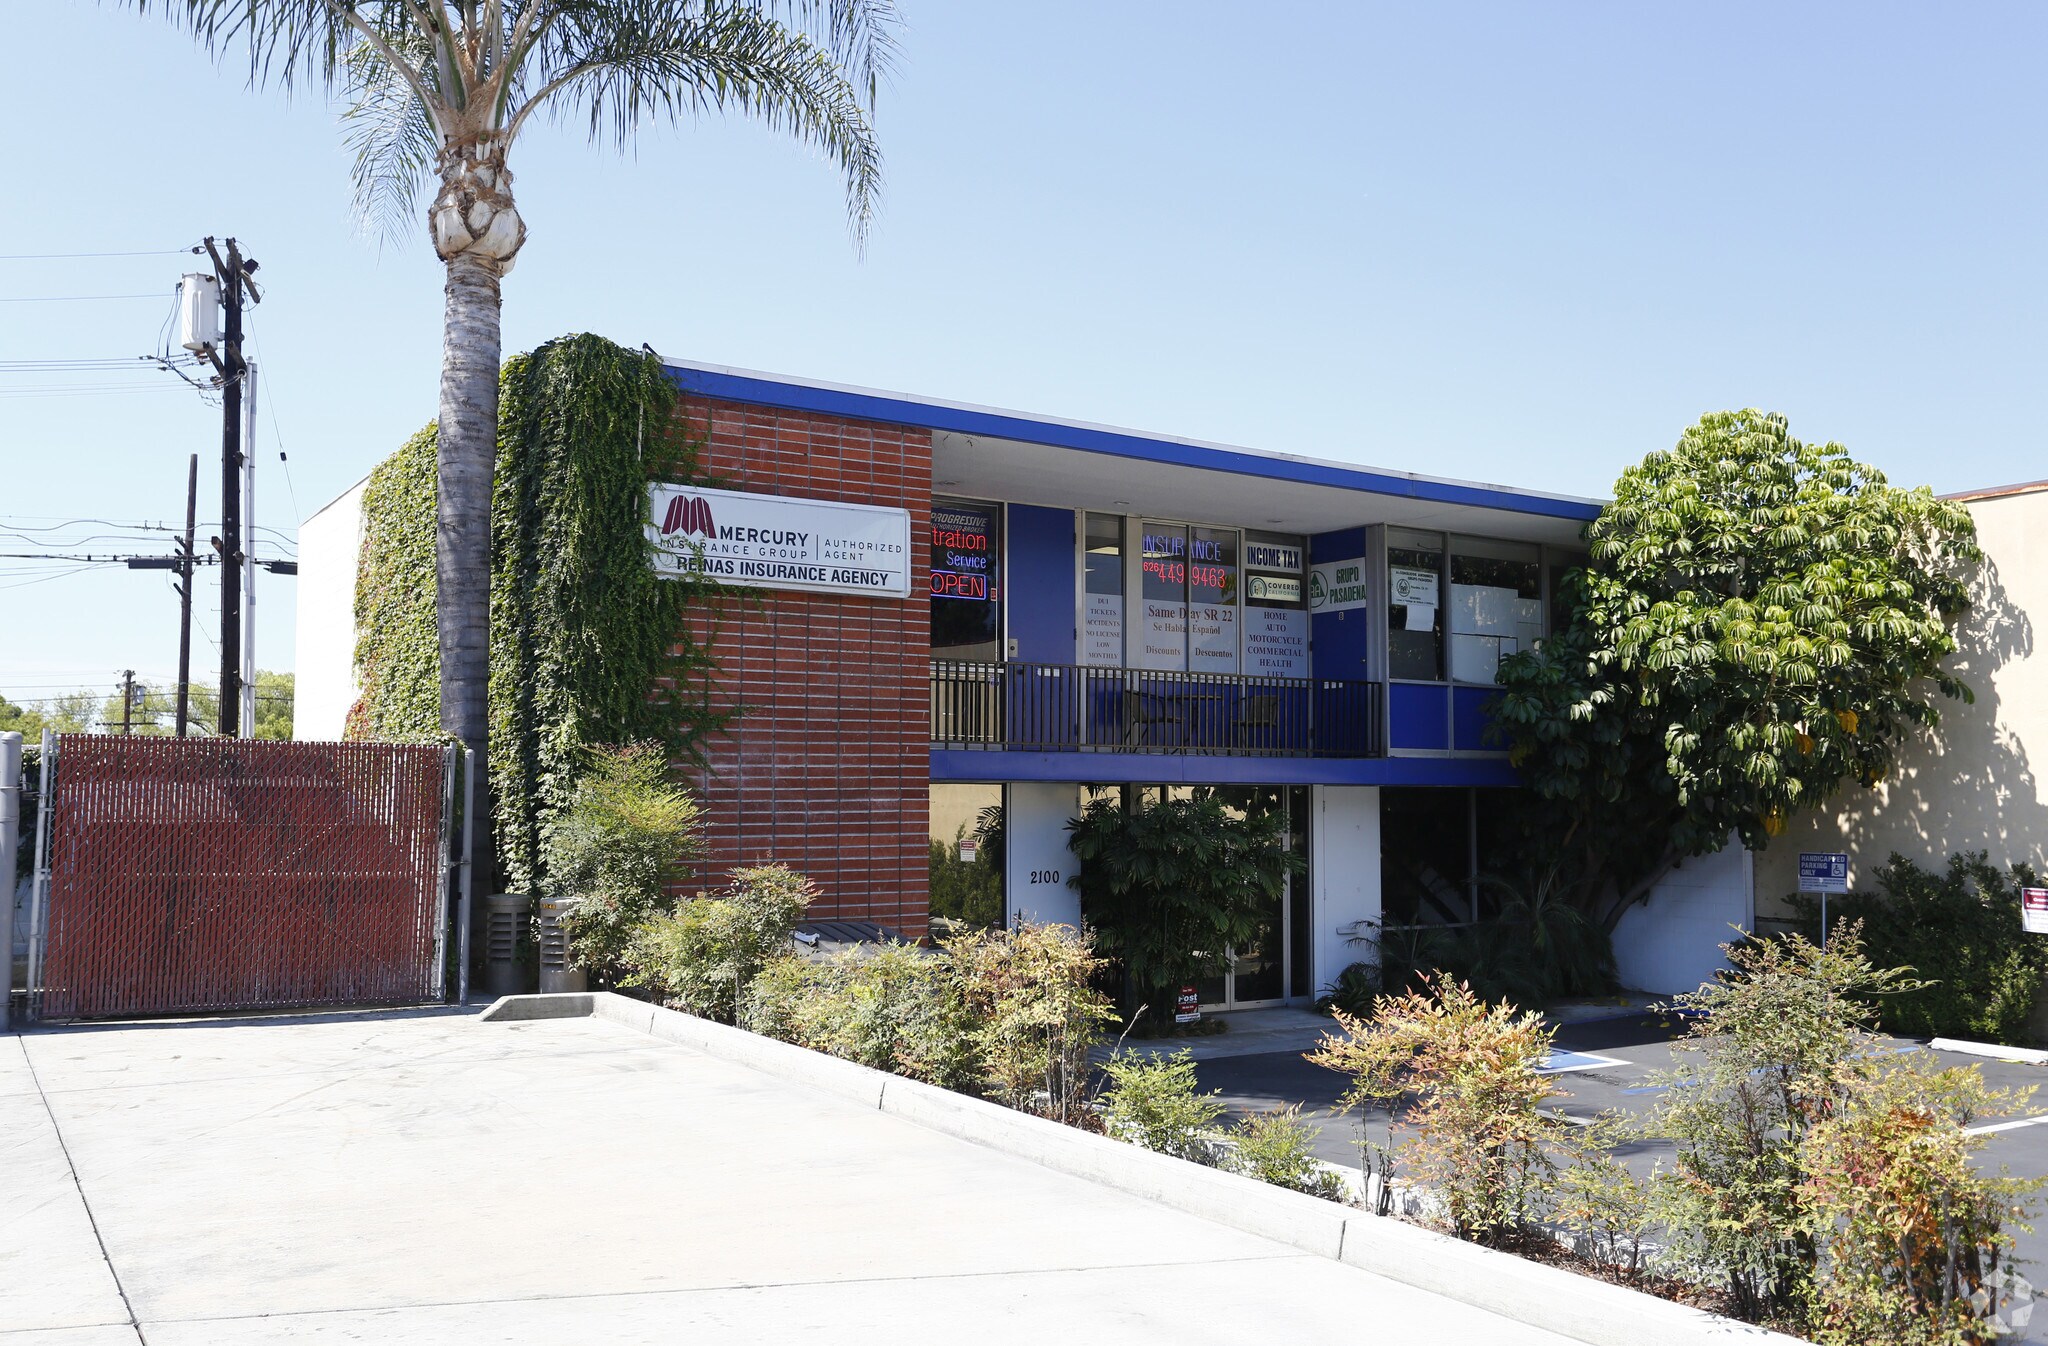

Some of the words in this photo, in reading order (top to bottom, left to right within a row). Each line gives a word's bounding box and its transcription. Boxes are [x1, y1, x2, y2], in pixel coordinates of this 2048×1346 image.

[931, 512, 988, 527] PROGRESSIVE
[720, 525, 809, 547] MERCURY
[932, 527, 986, 550] tration
[660, 539, 750, 555] INSURANCE
[759, 547, 808, 559] GROUP
[825, 539, 902, 553] AUTHORIZED
[825, 550, 864, 561] AGENT
[946, 551, 987, 569] Service
[1247, 546, 1280, 567] INCOME
[1283, 550, 1299, 569] TAX
[740, 561, 826, 581] INSURANCE
[831, 569, 889, 586] AGENCY
[1143, 562, 1159, 572] 626
[1158, 563, 1185, 583] 449
[1192, 566, 1226, 588] 9463
[1336, 566, 1359, 584] GRUPO
[930, 573, 983, 597] OPEN
[1268, 583, 1300, 591] COVERED
[1330, 584, 1366, 604] PASADENA
[1090, 608, 1117, 616] TICKETS
[1148, 604, 1175, 618] Same
[1179, 607, 1201, 622] Day
[1204, 608, 1218, 621] SR
[1222, 610, 1233, 622] 22
[1264, 611, 1288, 621] HOME
[1087, 619, 1120, 627] ACCIDENTS
[1153, 622, 1162, 631] Se
[1165, 622, 1187, 633] Habla
[1192, 624, 1221, 635] Español
[1266, 623, 1287, 632] AUTO
[1249, 634, 1303, 645] MOTORCYCLE
[1146, 645, 1181, 656] Discounts
[1195, 647, 1233, 658] Descuentos
[1247, 645, 1304, 657] COMMERCIAL
[1260, 658, 1292, 668] HEALTH
[1801, 861, 1828, 870] PARKING
[1801, 868, 1817, 876] ONLY
[1030, 870, 1060, 884] 2100
